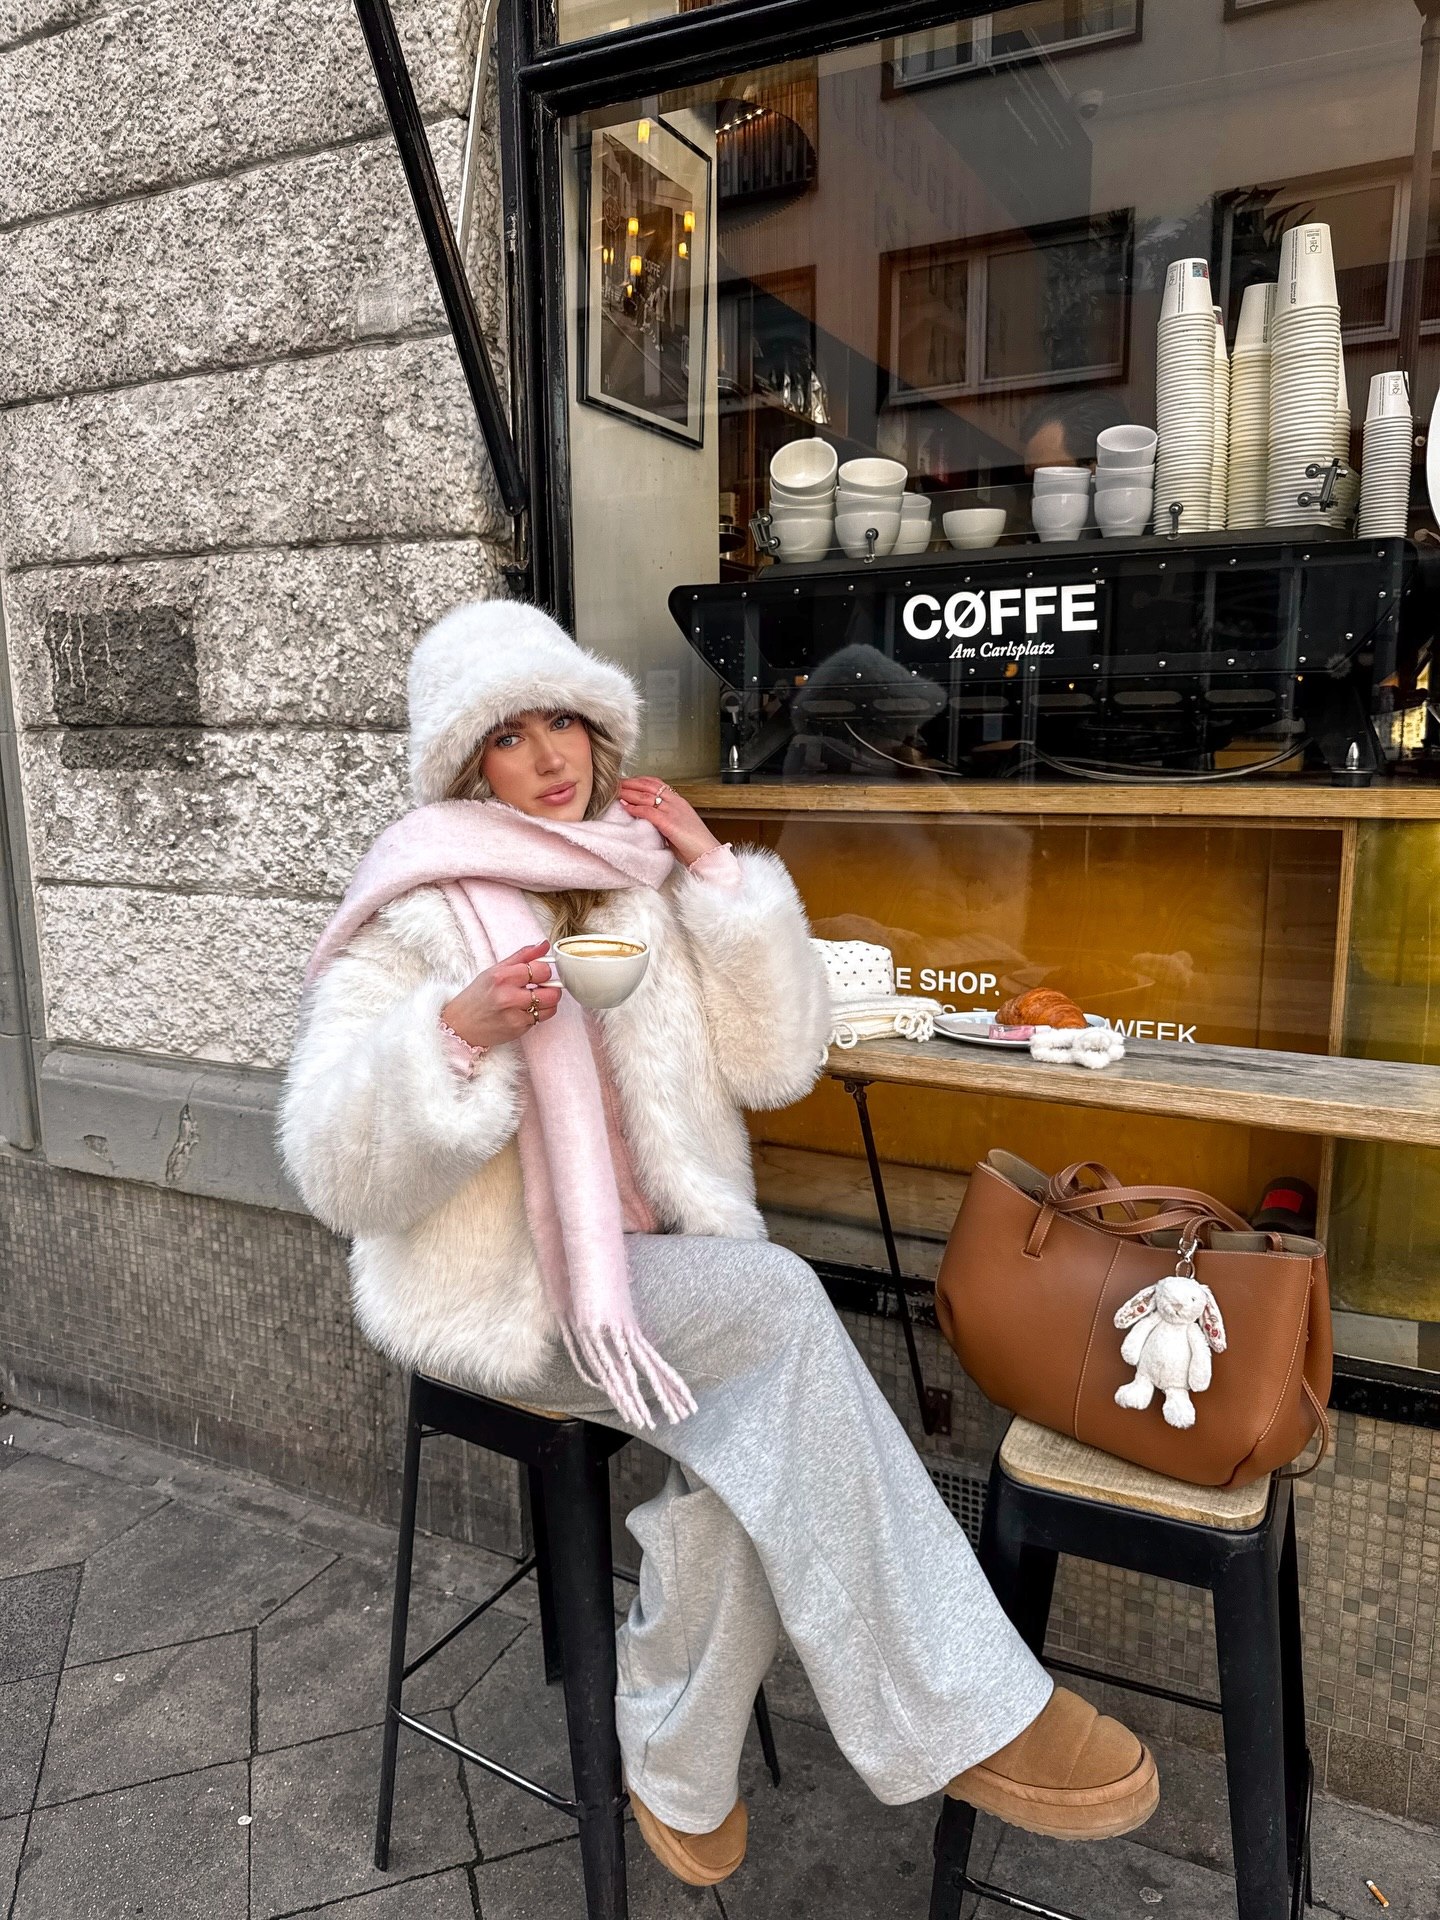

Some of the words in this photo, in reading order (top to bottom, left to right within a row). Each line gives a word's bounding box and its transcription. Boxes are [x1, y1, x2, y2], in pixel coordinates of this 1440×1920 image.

[902, 584, 1098, 640] CØFFE
[949, 643, 976, 659] Am
[979, 640, 1055, 661] Carlsplatz
[919, 968, 1000, 997] SHOP.
[1104, 1017, 1198, 1044] WEEK
